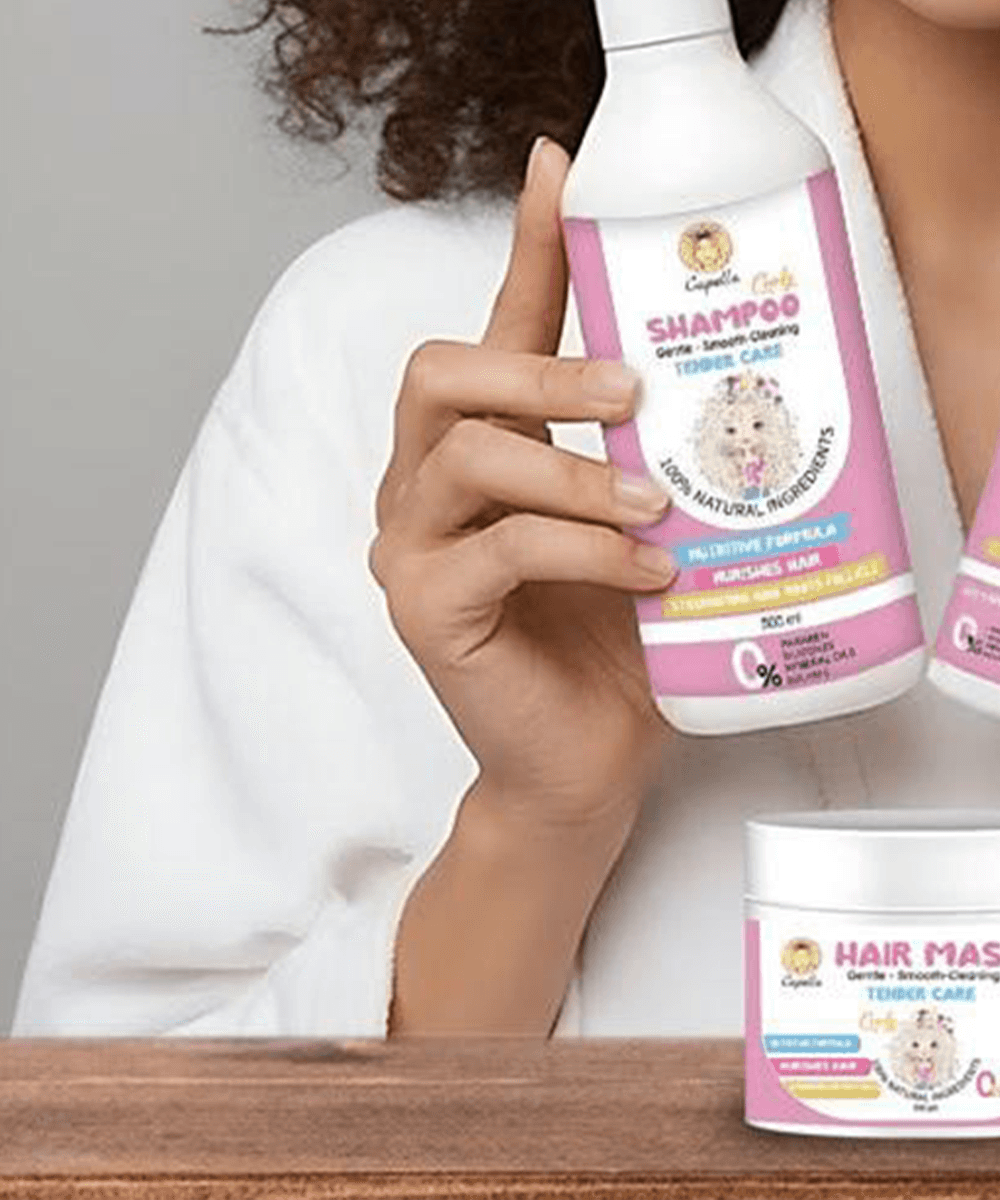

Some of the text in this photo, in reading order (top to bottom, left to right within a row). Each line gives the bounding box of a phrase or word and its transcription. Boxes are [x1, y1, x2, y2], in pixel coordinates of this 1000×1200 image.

[646, 294, 800, 343] SHAMPOO
[674, 343, 782, 376] TENDER CARE
[660, 425, 836, 517] 100% NATURAL INGREDIENTS
[834, 941, 912, 967] HAIR
[846, 969, 886, 981] Gentle
[867, 986, 977, 1001] TENDER CARE
